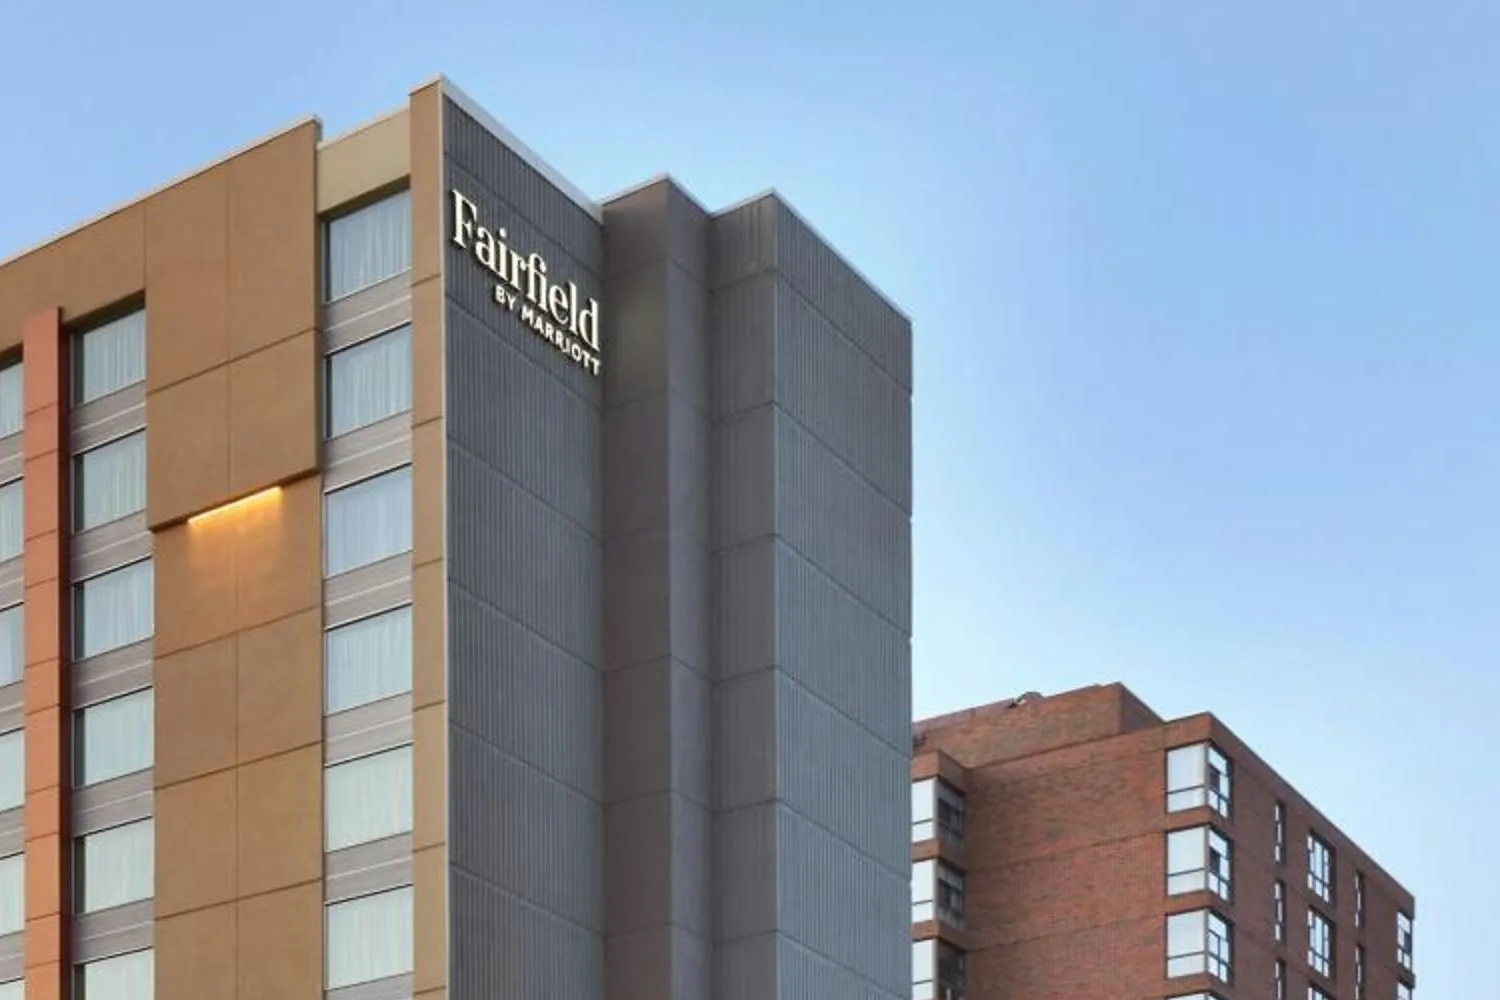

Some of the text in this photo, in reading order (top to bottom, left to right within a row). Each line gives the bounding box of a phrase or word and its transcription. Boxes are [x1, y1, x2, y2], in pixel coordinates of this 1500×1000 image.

[452, 188, 600, 351] Fairfield
[495, 285, 600, 375] BY MARRIOTT
